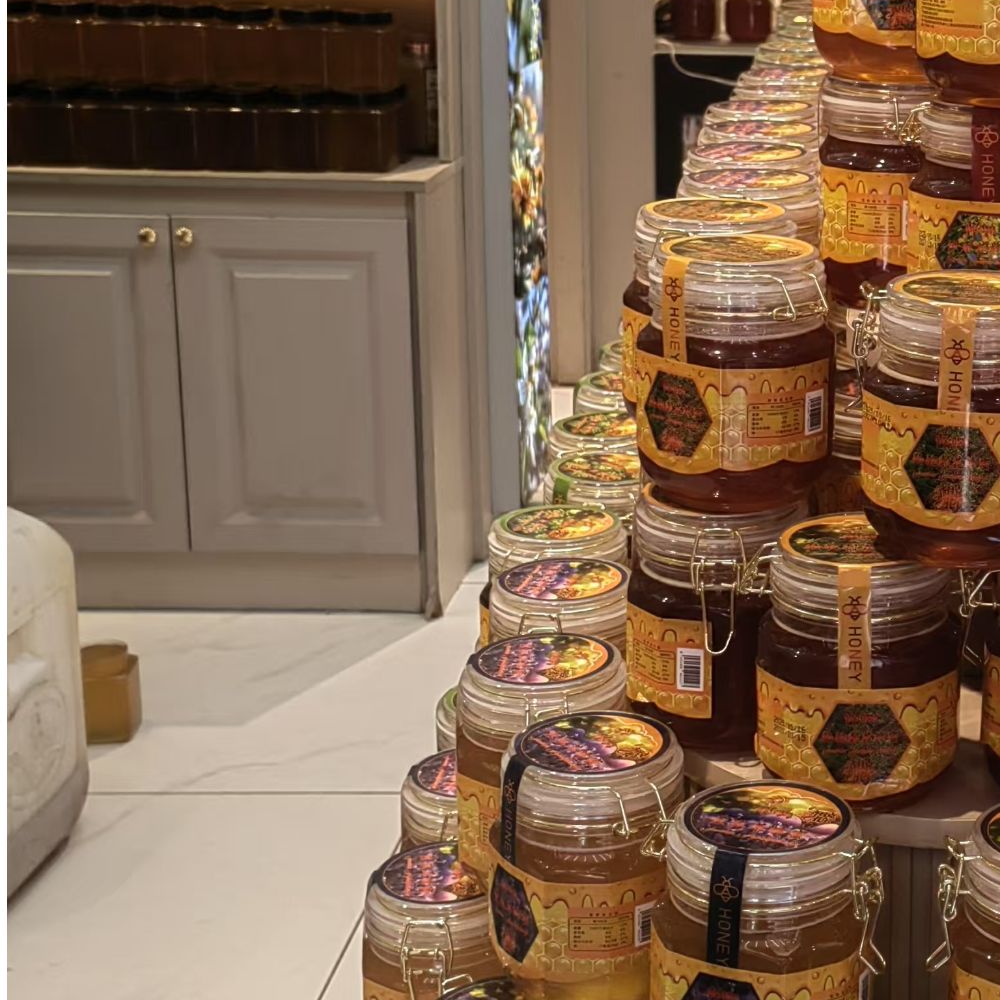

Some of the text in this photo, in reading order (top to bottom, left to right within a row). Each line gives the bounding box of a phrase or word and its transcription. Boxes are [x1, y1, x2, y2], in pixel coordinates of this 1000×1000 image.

[981, 153, 996, 202] HONE
[669, 306, 681, 361] HONEY
[946, 370, 963, 411] HON
[847, 626, 863, 683] HONEY
[717, 907, 733, 967] HONEY
